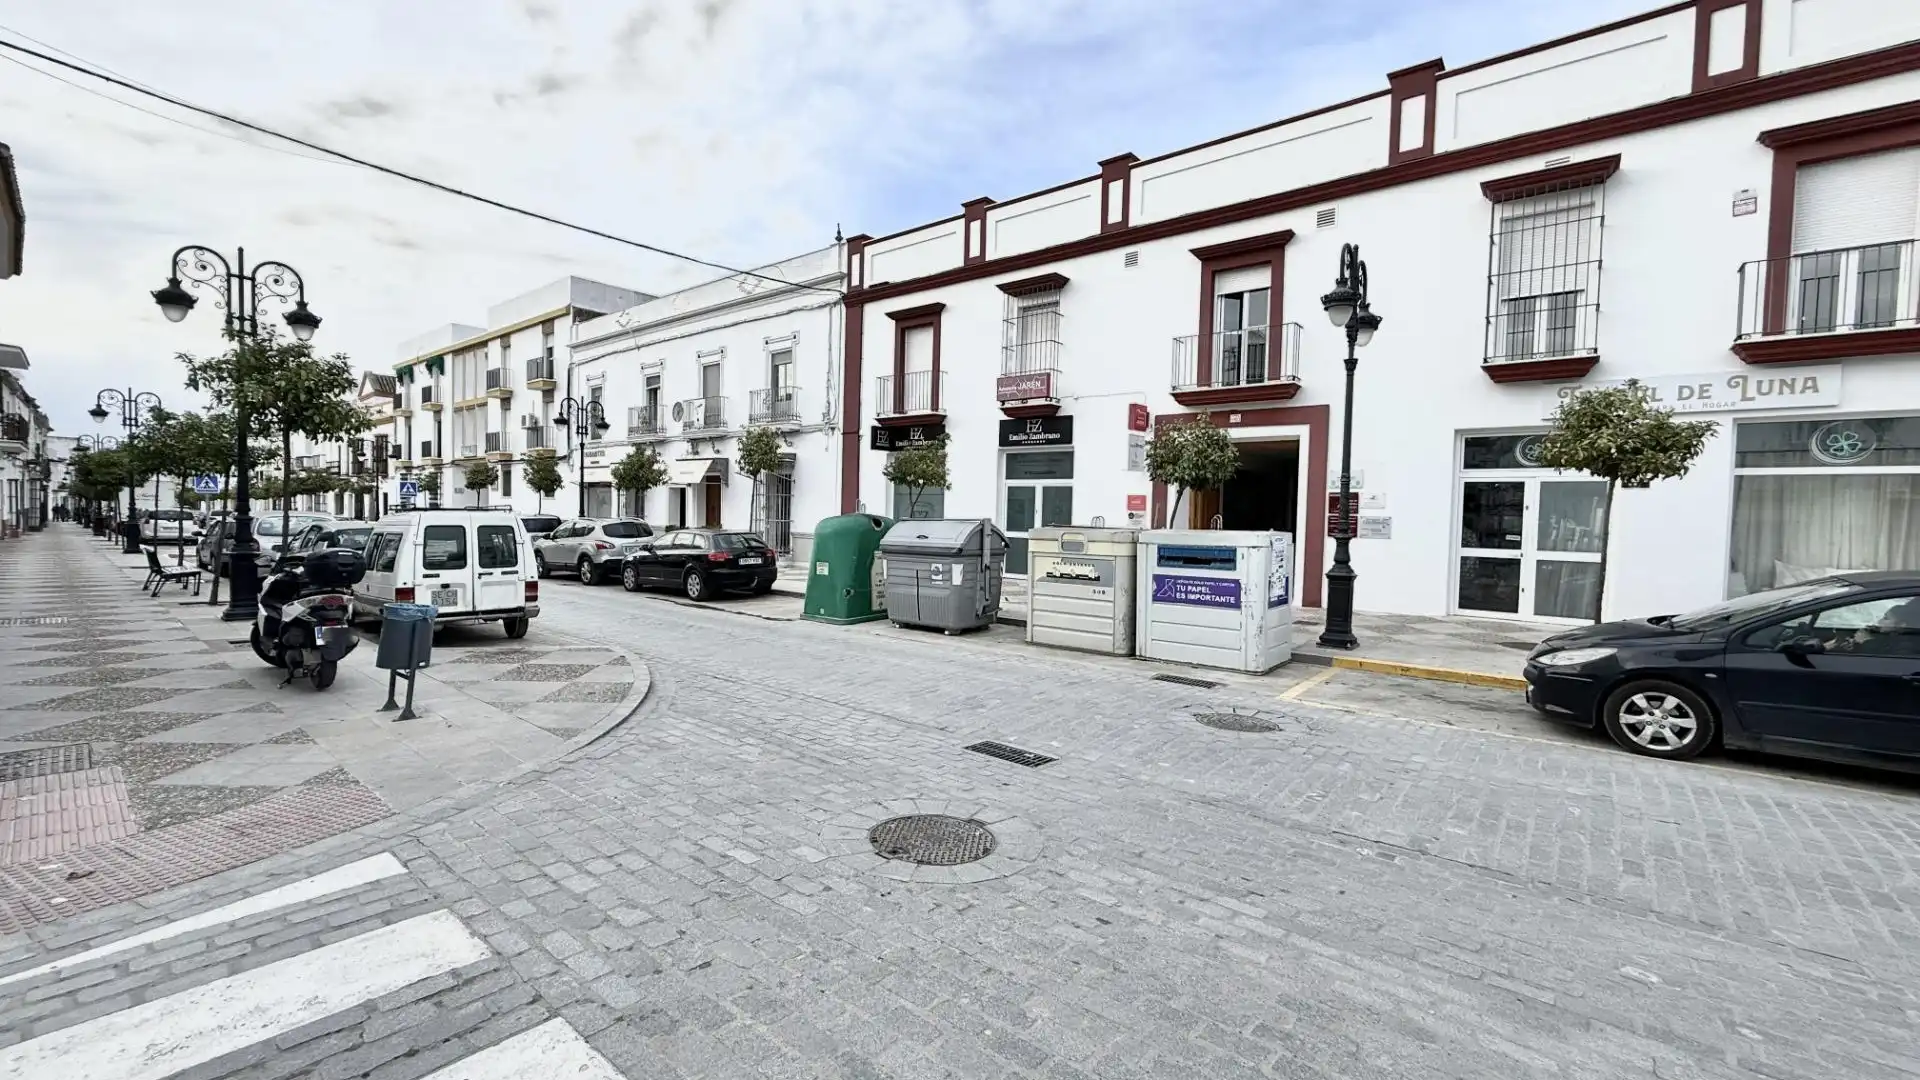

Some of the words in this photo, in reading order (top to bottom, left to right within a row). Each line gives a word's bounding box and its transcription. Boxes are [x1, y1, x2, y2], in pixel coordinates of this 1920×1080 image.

[1677, 383, 1713, 401] DE
[1726, 374, 1819, 402] LUNA
[1702, 401, 1737, 409] HOGAR
[1029, 432, 1061, 440] Zambrano
[1187, 594, 1236, 604] IMPORTANTE
